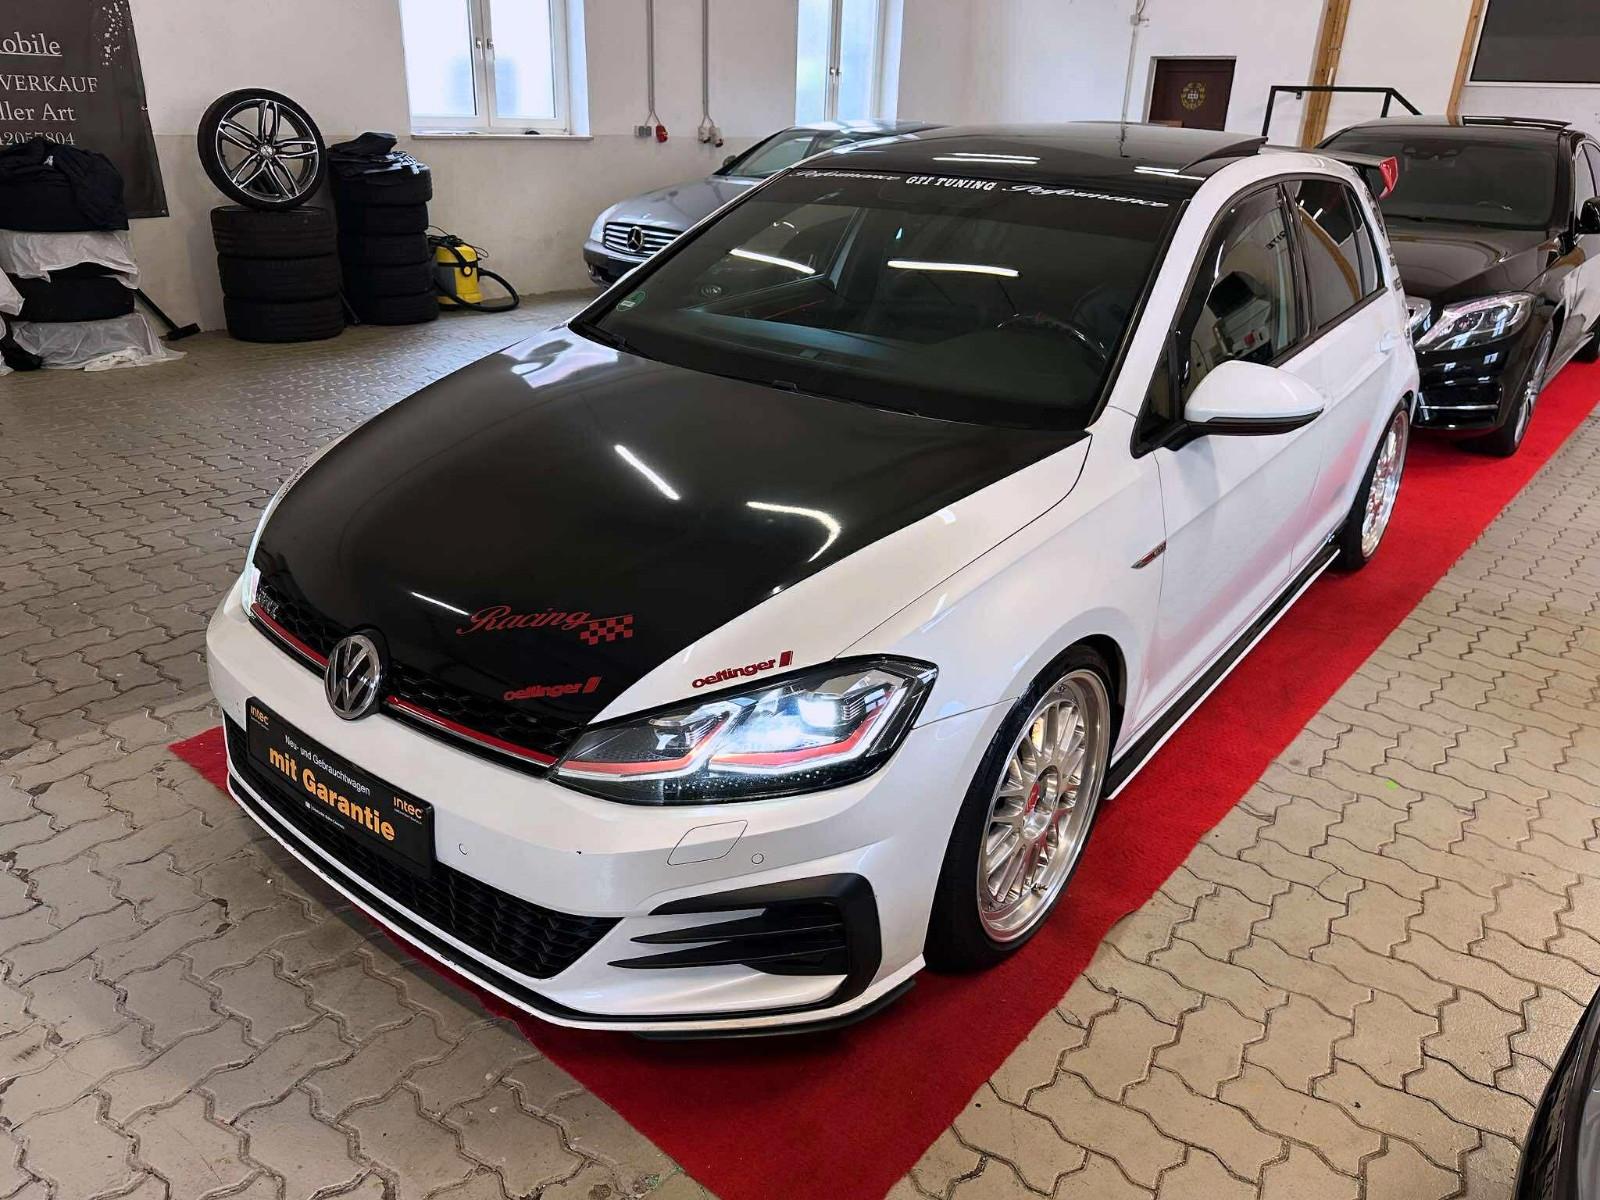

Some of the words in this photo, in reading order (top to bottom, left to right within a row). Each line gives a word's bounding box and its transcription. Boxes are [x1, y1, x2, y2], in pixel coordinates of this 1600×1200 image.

[0, 31, 62, 56] obile
[41, 102, 76, 121] Art
[905, 175, 935, 185] GTI
[934, 177, 998, 192] TUNING
[455, 604, 592, 635] Racing
[691, 657, 777, 690] oettinger
[503, 681, 585, 701] oettinger
[299, 747, 312, 761] und
[312, 754, 371, 797] Gebrauchtwagen
[268, 746, 298, 783] mit
[302, 767, 396, 842] Garantie
